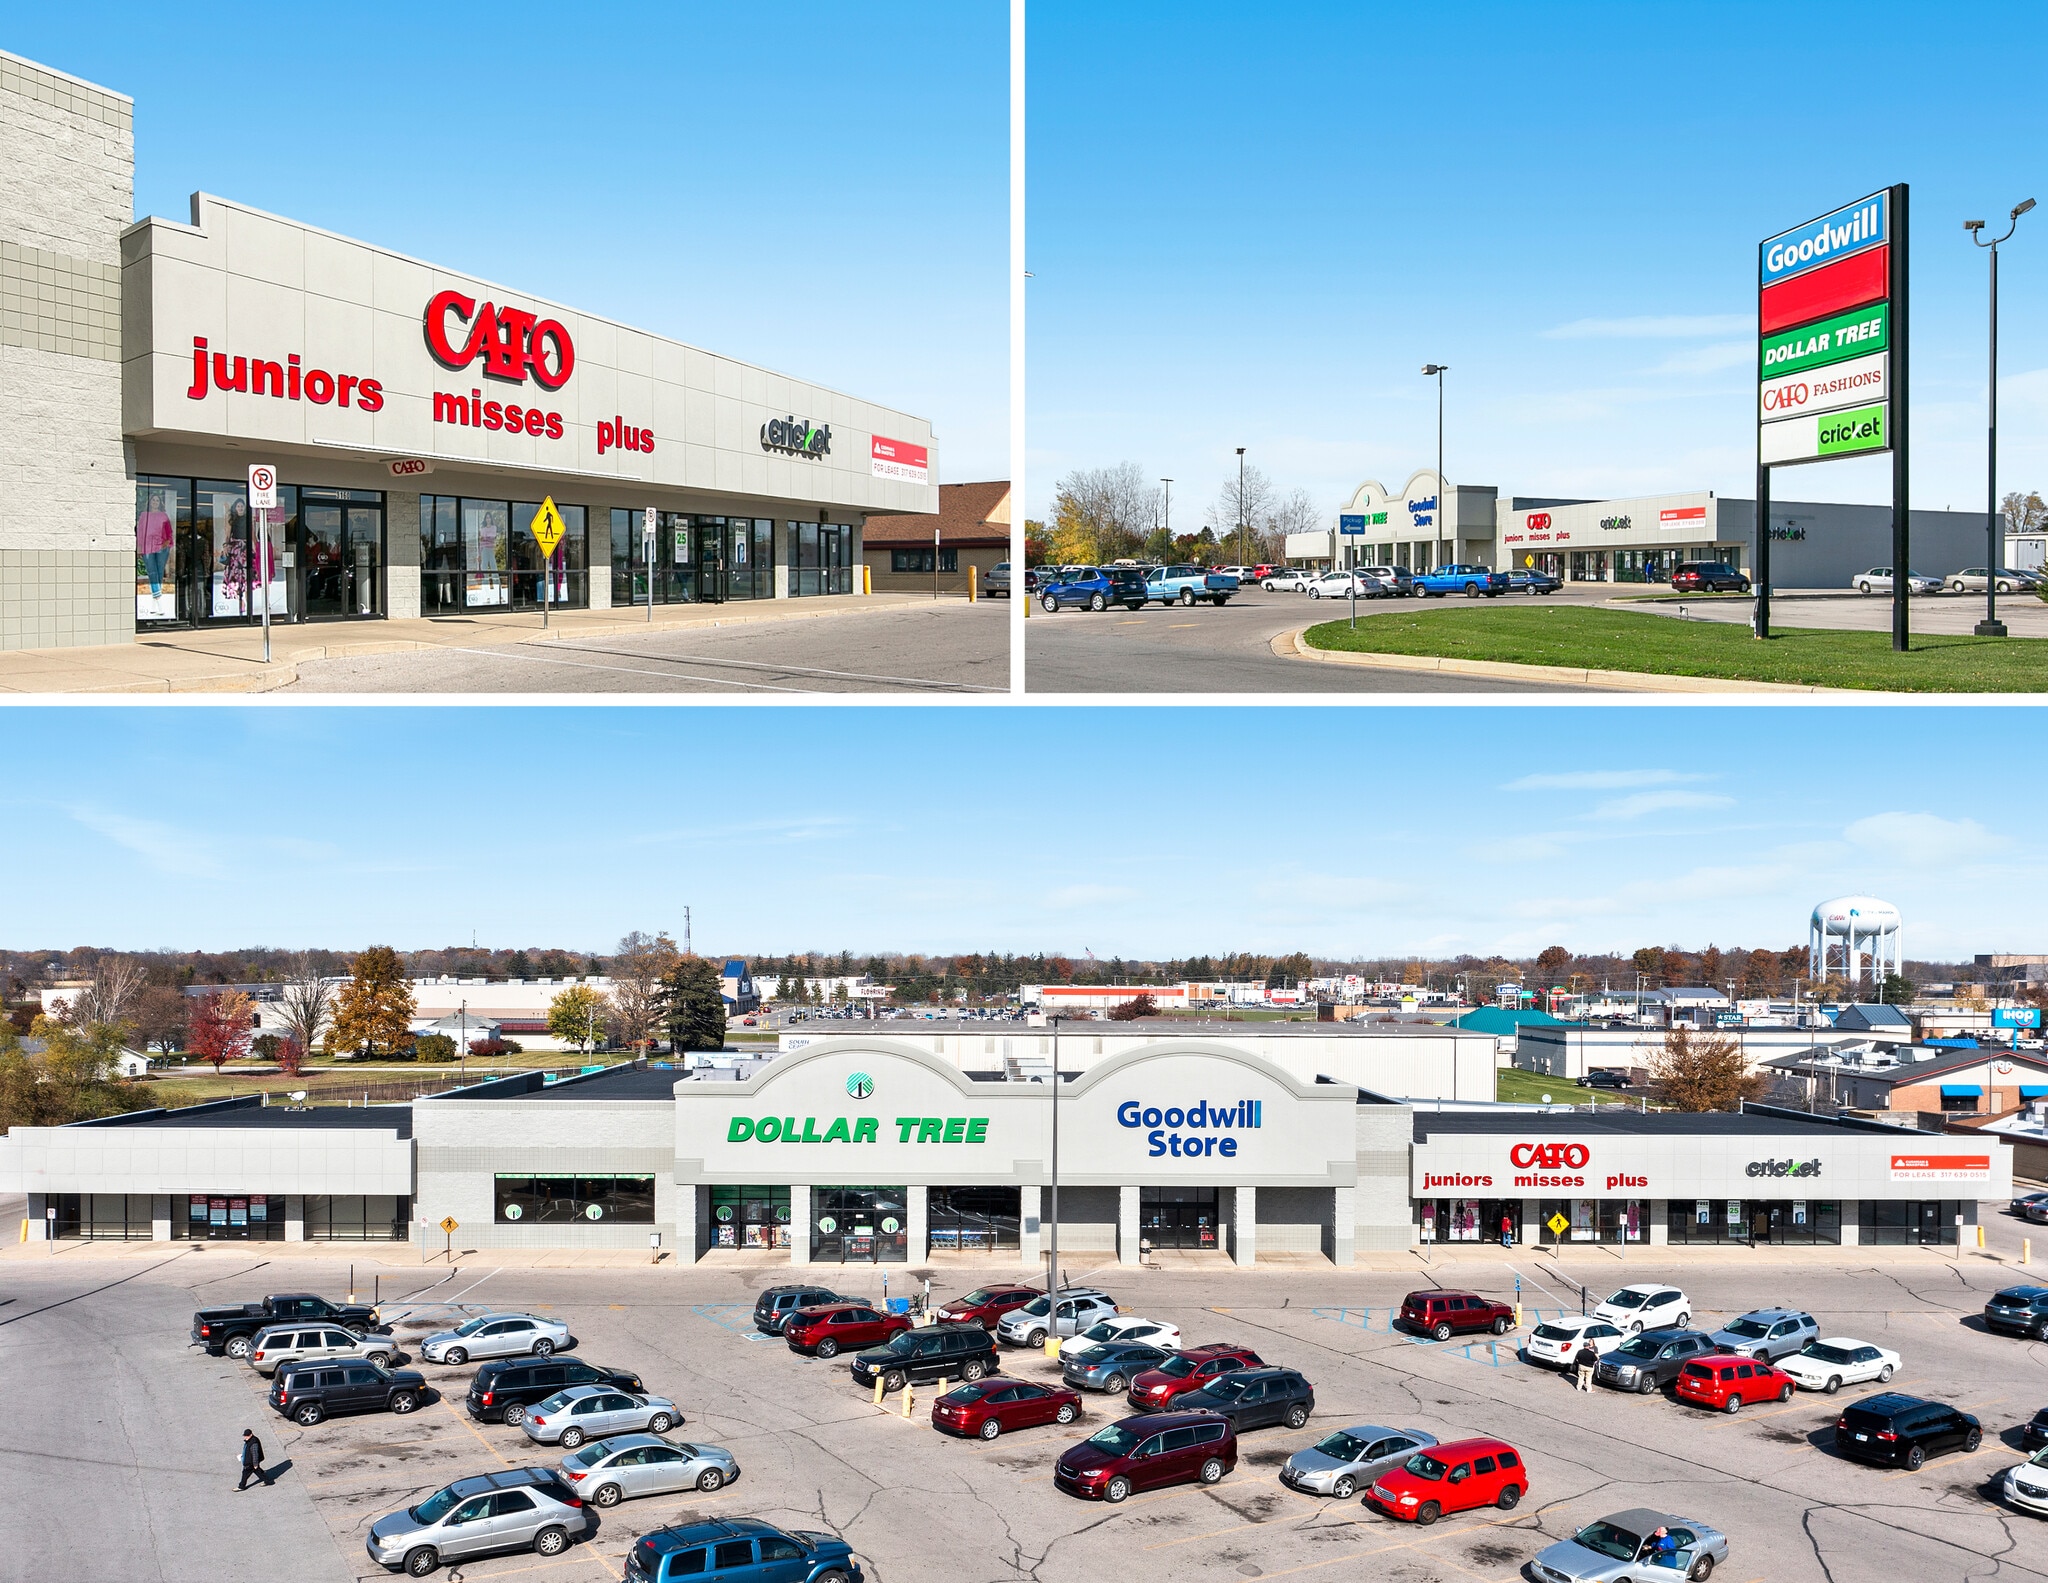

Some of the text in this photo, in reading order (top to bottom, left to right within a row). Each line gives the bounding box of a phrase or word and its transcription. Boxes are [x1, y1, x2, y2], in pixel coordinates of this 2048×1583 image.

[1766, 203, 1879, 273] Goodwill
[425, 290, 575, 390] CATO
[1764, 316, 1882, 367] DOLLAR TREE
[188, 336, 654, 454] juniors misses plus
[1763, 370, 1881, 411] CATO FASHIONS
[762, 415, 832, 459] cricket
[1819, 416, 1881, 445] cricket
[391, 459, 425, 474] CATO
[873, 463, 884, 473] FOR
[885, 465, 899, 476] LEASE
[1343, 516, 1362, 524] Pickup
[1371, 512, 1388, 525] TREE
[1413, 513, 1433, 527] Store
[1504, 530, 1571, 544] juniors misses plus
[1116, 1100, 1262, 1129] Goodwill
[727, 1116, 990, 1143] DOLLAR TREE
[1148, 1131, 1238, 1158] Store
[1509, 1142, 1590, 1169] CATO
[1423, 1171, 1648, 1191] juniors misses plus
[1745, 1158, 1822, 1177] cricket
